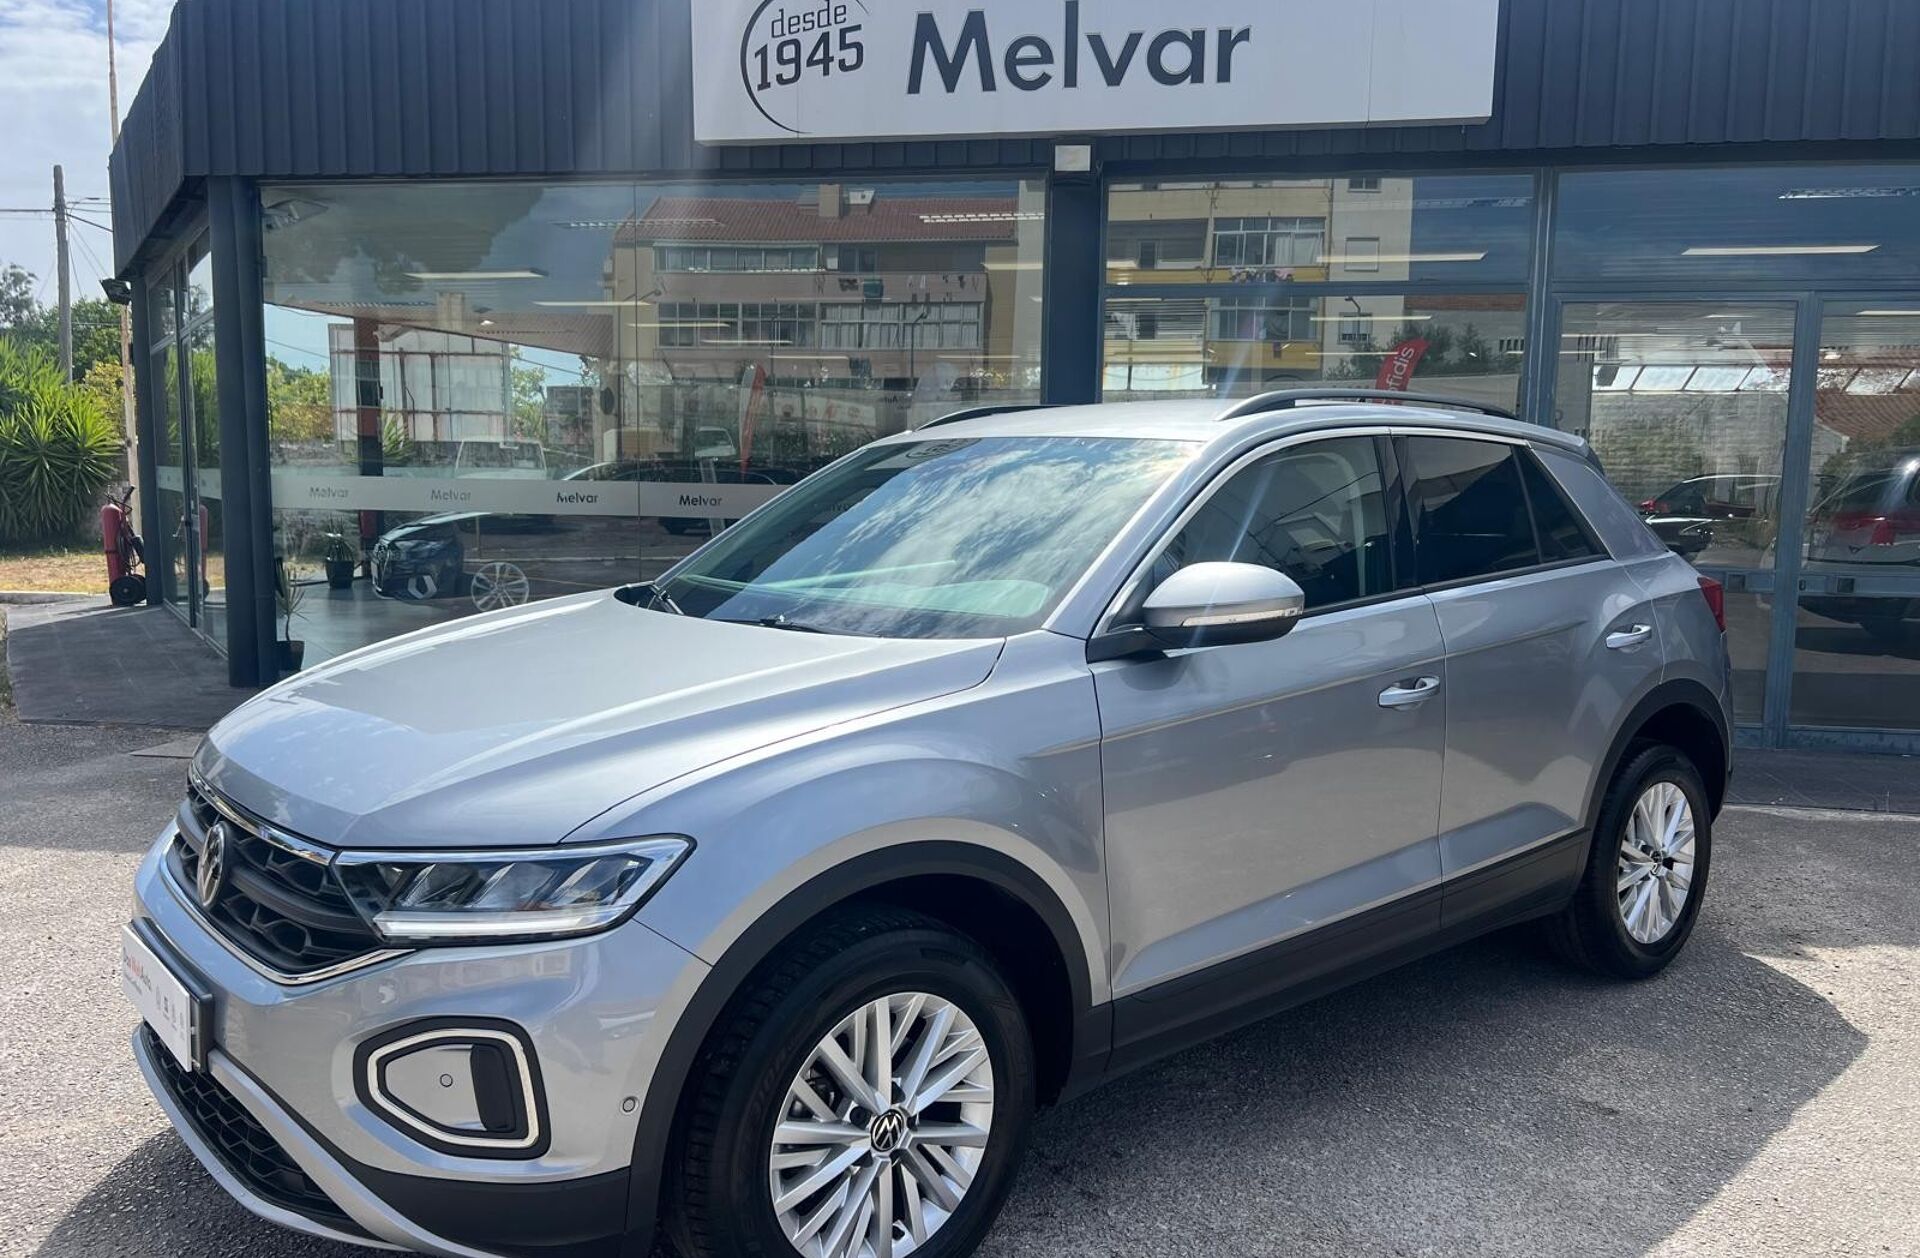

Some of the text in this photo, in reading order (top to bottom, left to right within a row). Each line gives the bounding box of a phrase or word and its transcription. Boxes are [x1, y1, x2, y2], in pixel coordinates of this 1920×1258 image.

[771, 0, 847, 39] desde
[754, 24, 864, 91] 1945
[907, 0, 1251, 94] Melvar
[1385, 347, 1415, 394] fidis
[556, 491, 599, 504] Melvar
[678, 494, 723, 507] Melvar
